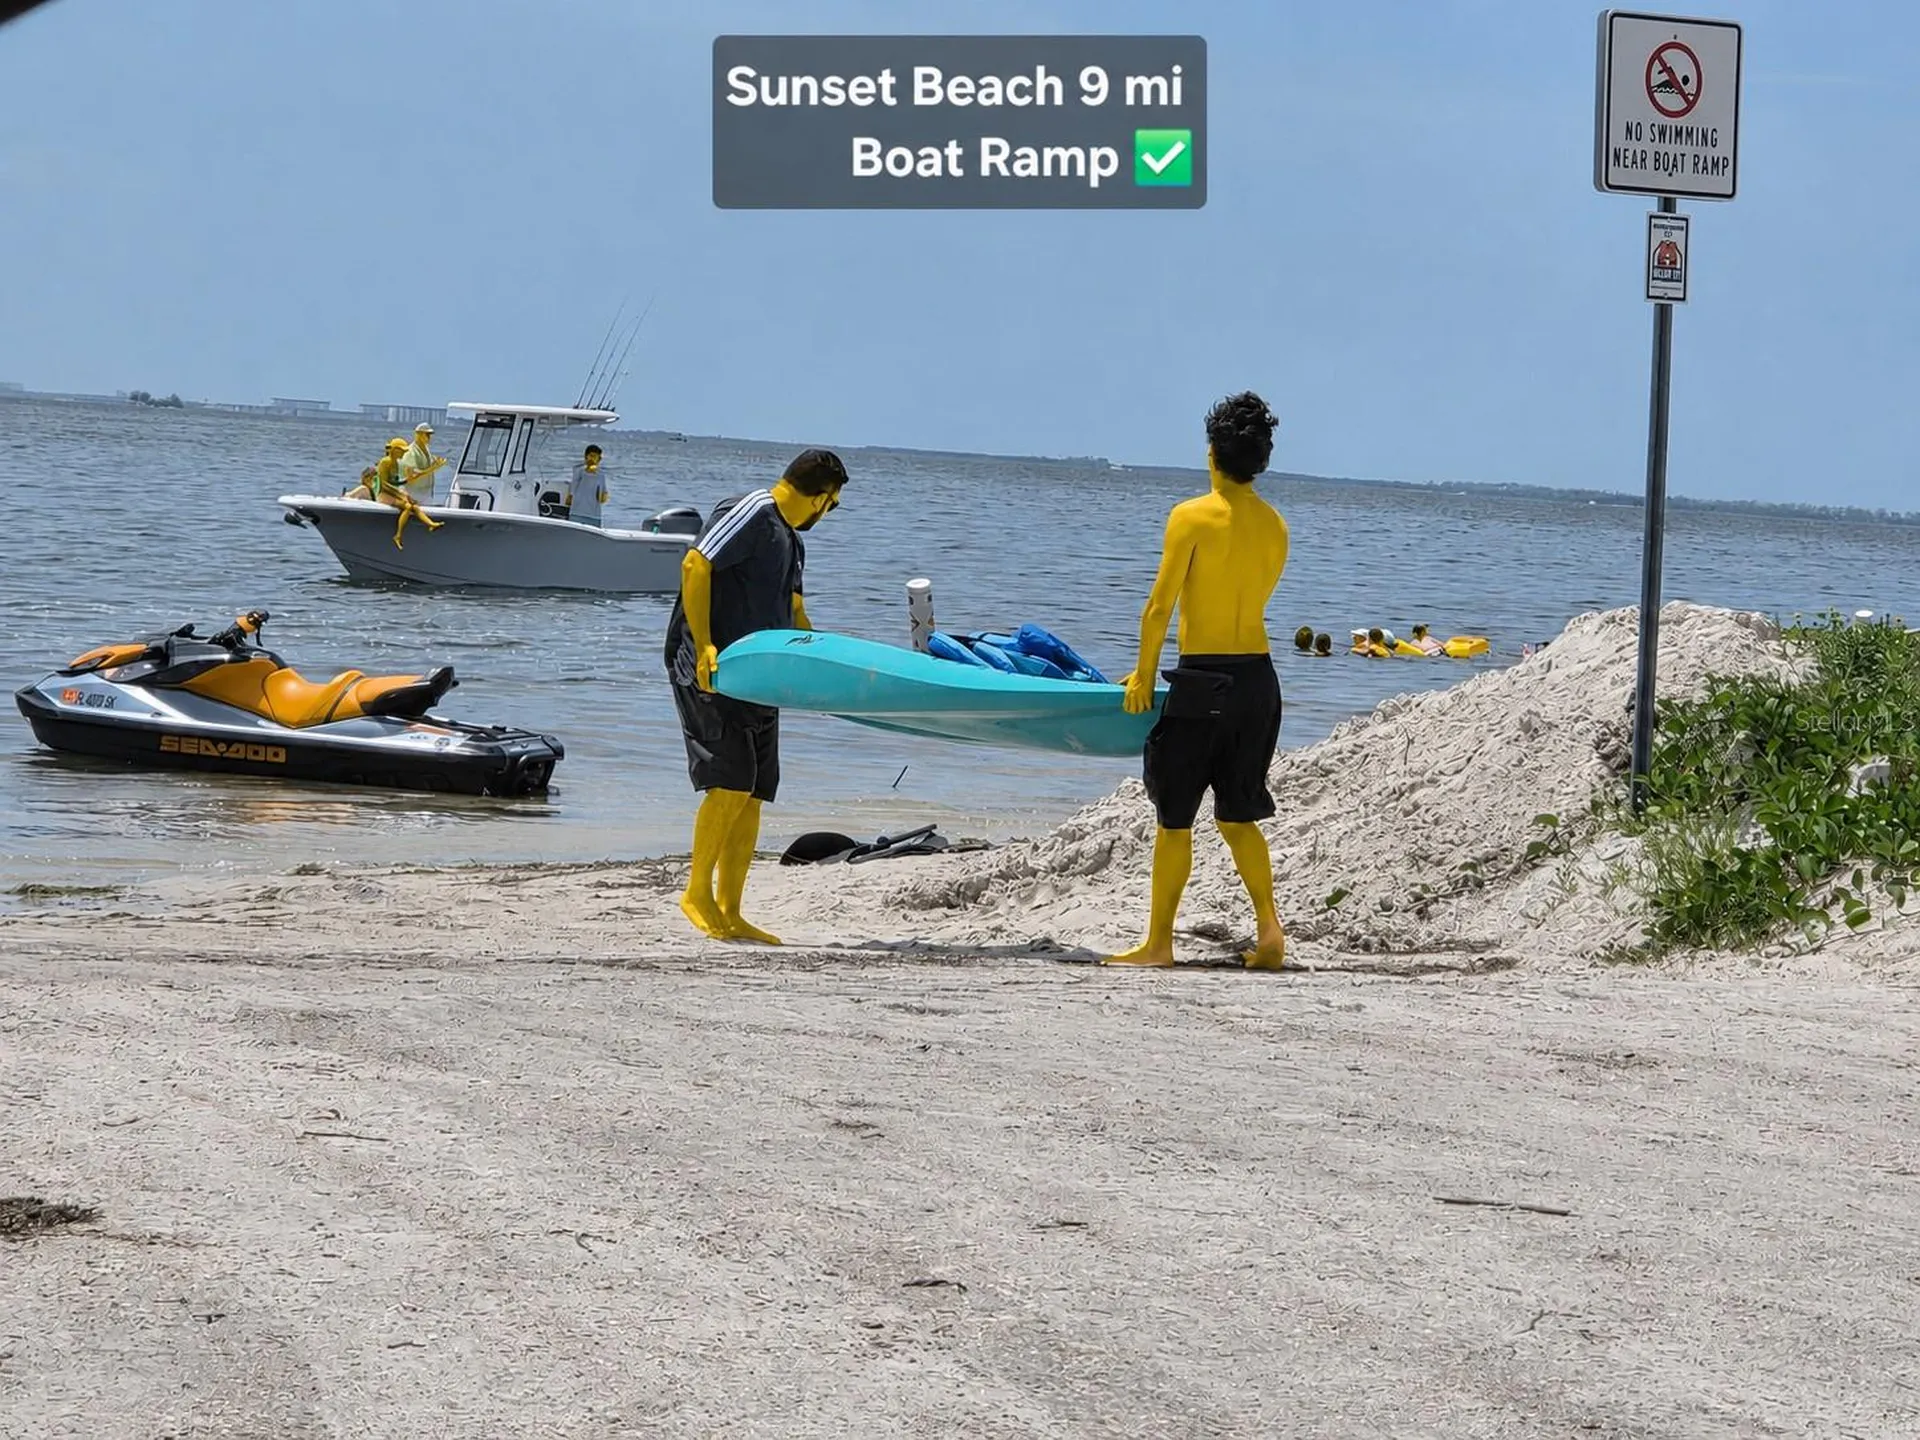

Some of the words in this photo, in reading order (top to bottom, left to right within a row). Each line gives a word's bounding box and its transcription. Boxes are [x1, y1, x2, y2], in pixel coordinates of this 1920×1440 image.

[1625, 121, 1642, 142] NO
[1650, 123, 1718, 148] SWIMMING
[1613, 147, 1648, 170] NEAR
[1654, 151, 1686, 174] BOAT
[1693, 154, 1729, 177] RAMP
